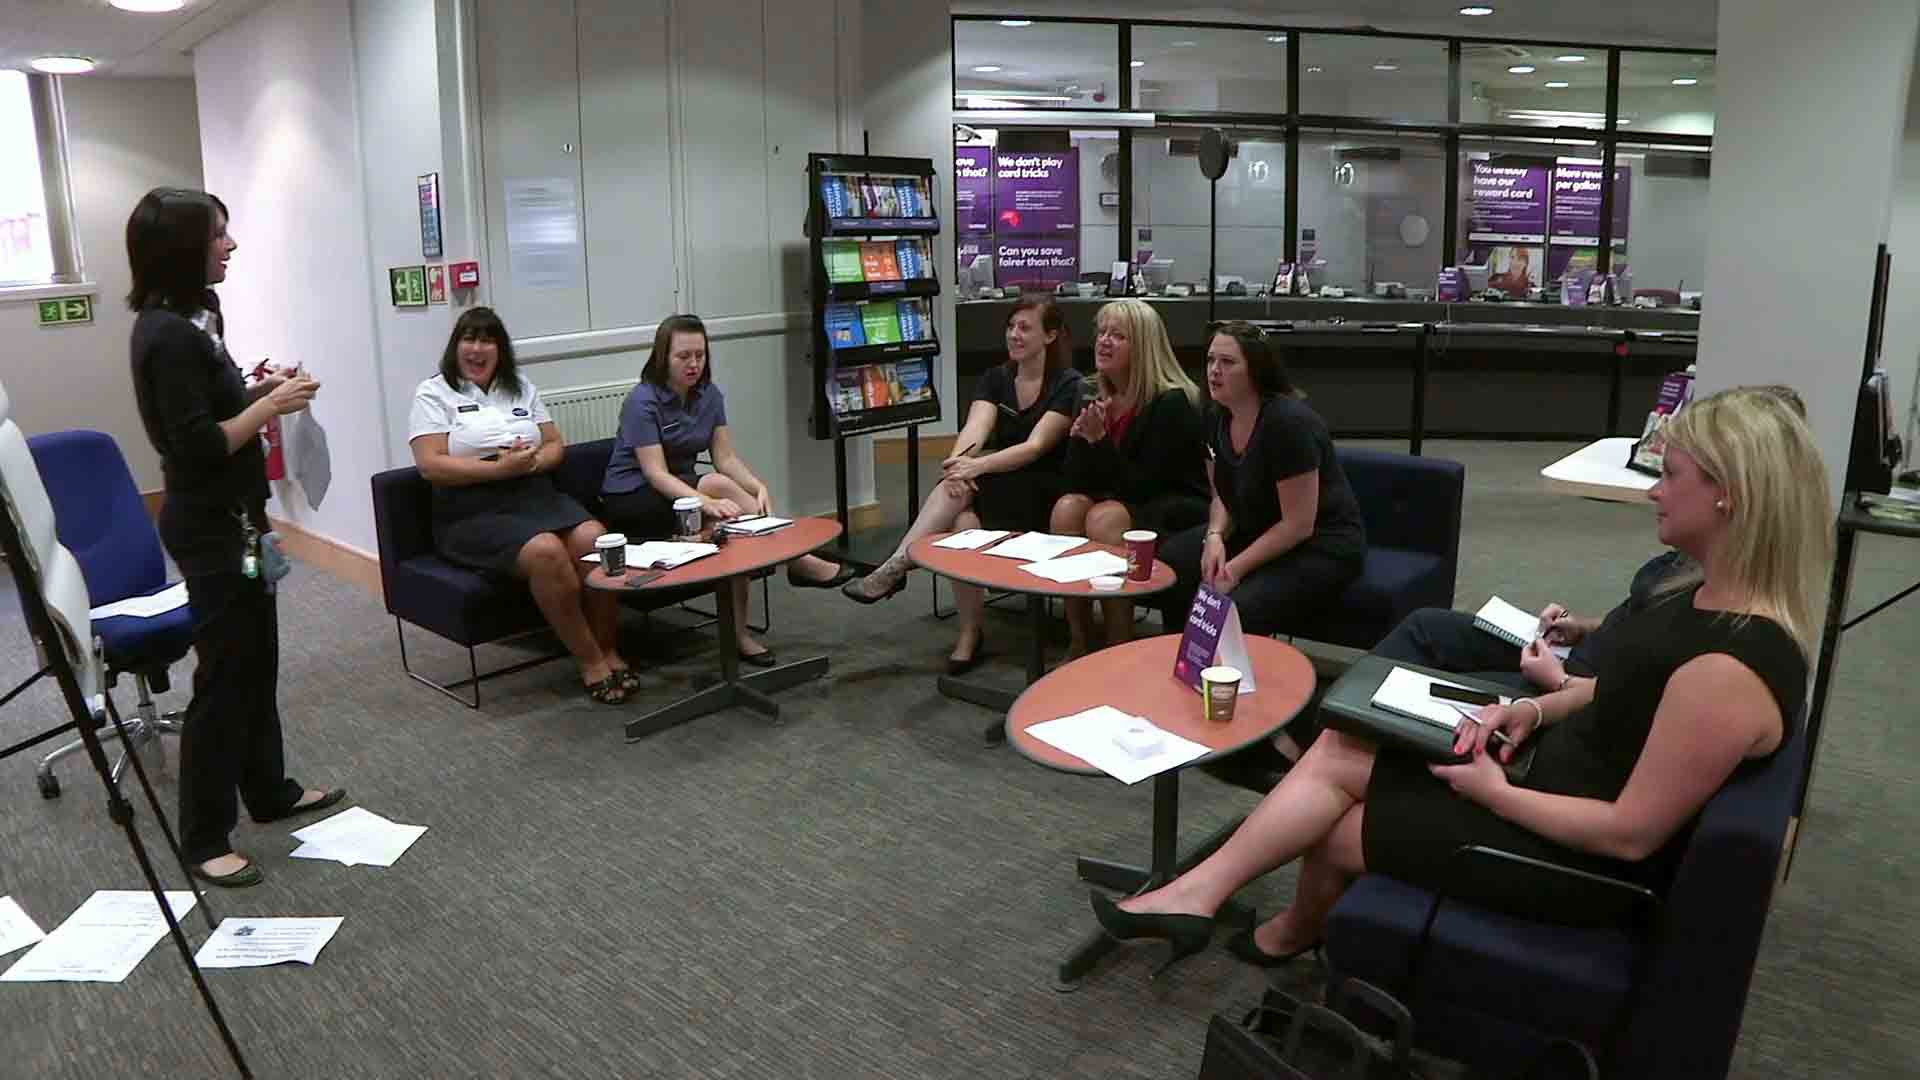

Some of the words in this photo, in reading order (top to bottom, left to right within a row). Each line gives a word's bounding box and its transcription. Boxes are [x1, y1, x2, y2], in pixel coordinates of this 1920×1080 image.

[956, 158, 975, 167] ave
[998, 156, 1014, 168] We
[1016, 156, 1040, 168] don't
[1042, 157, 1063, 169] play
[962, 167, 988, 177] that?
[998, 168, 1021, 178] card
[1022, 168, 1049, 178] tricks
[1474, 163, 1491, 175] You
[1556, 167, 1580, 178] More
[1473, 175, 1497, 185] have
[1497, 178, 1516, 186] our
[1556, 181, 1572, 191] per
[1572, 180, 1601, 192] gallon
[1473, 188, 1510, 198] reward
[1510, 189, 1534, 199] card
[998, 246, 1019, 256] Can
[1020, 248, 1039, 258] you
[1040, 248, 1063, 256] save
[999, 257, 1026, 267] fairer
[1027, 257, 1050, 267] than
[1051, 257, 1076, 267] that?
